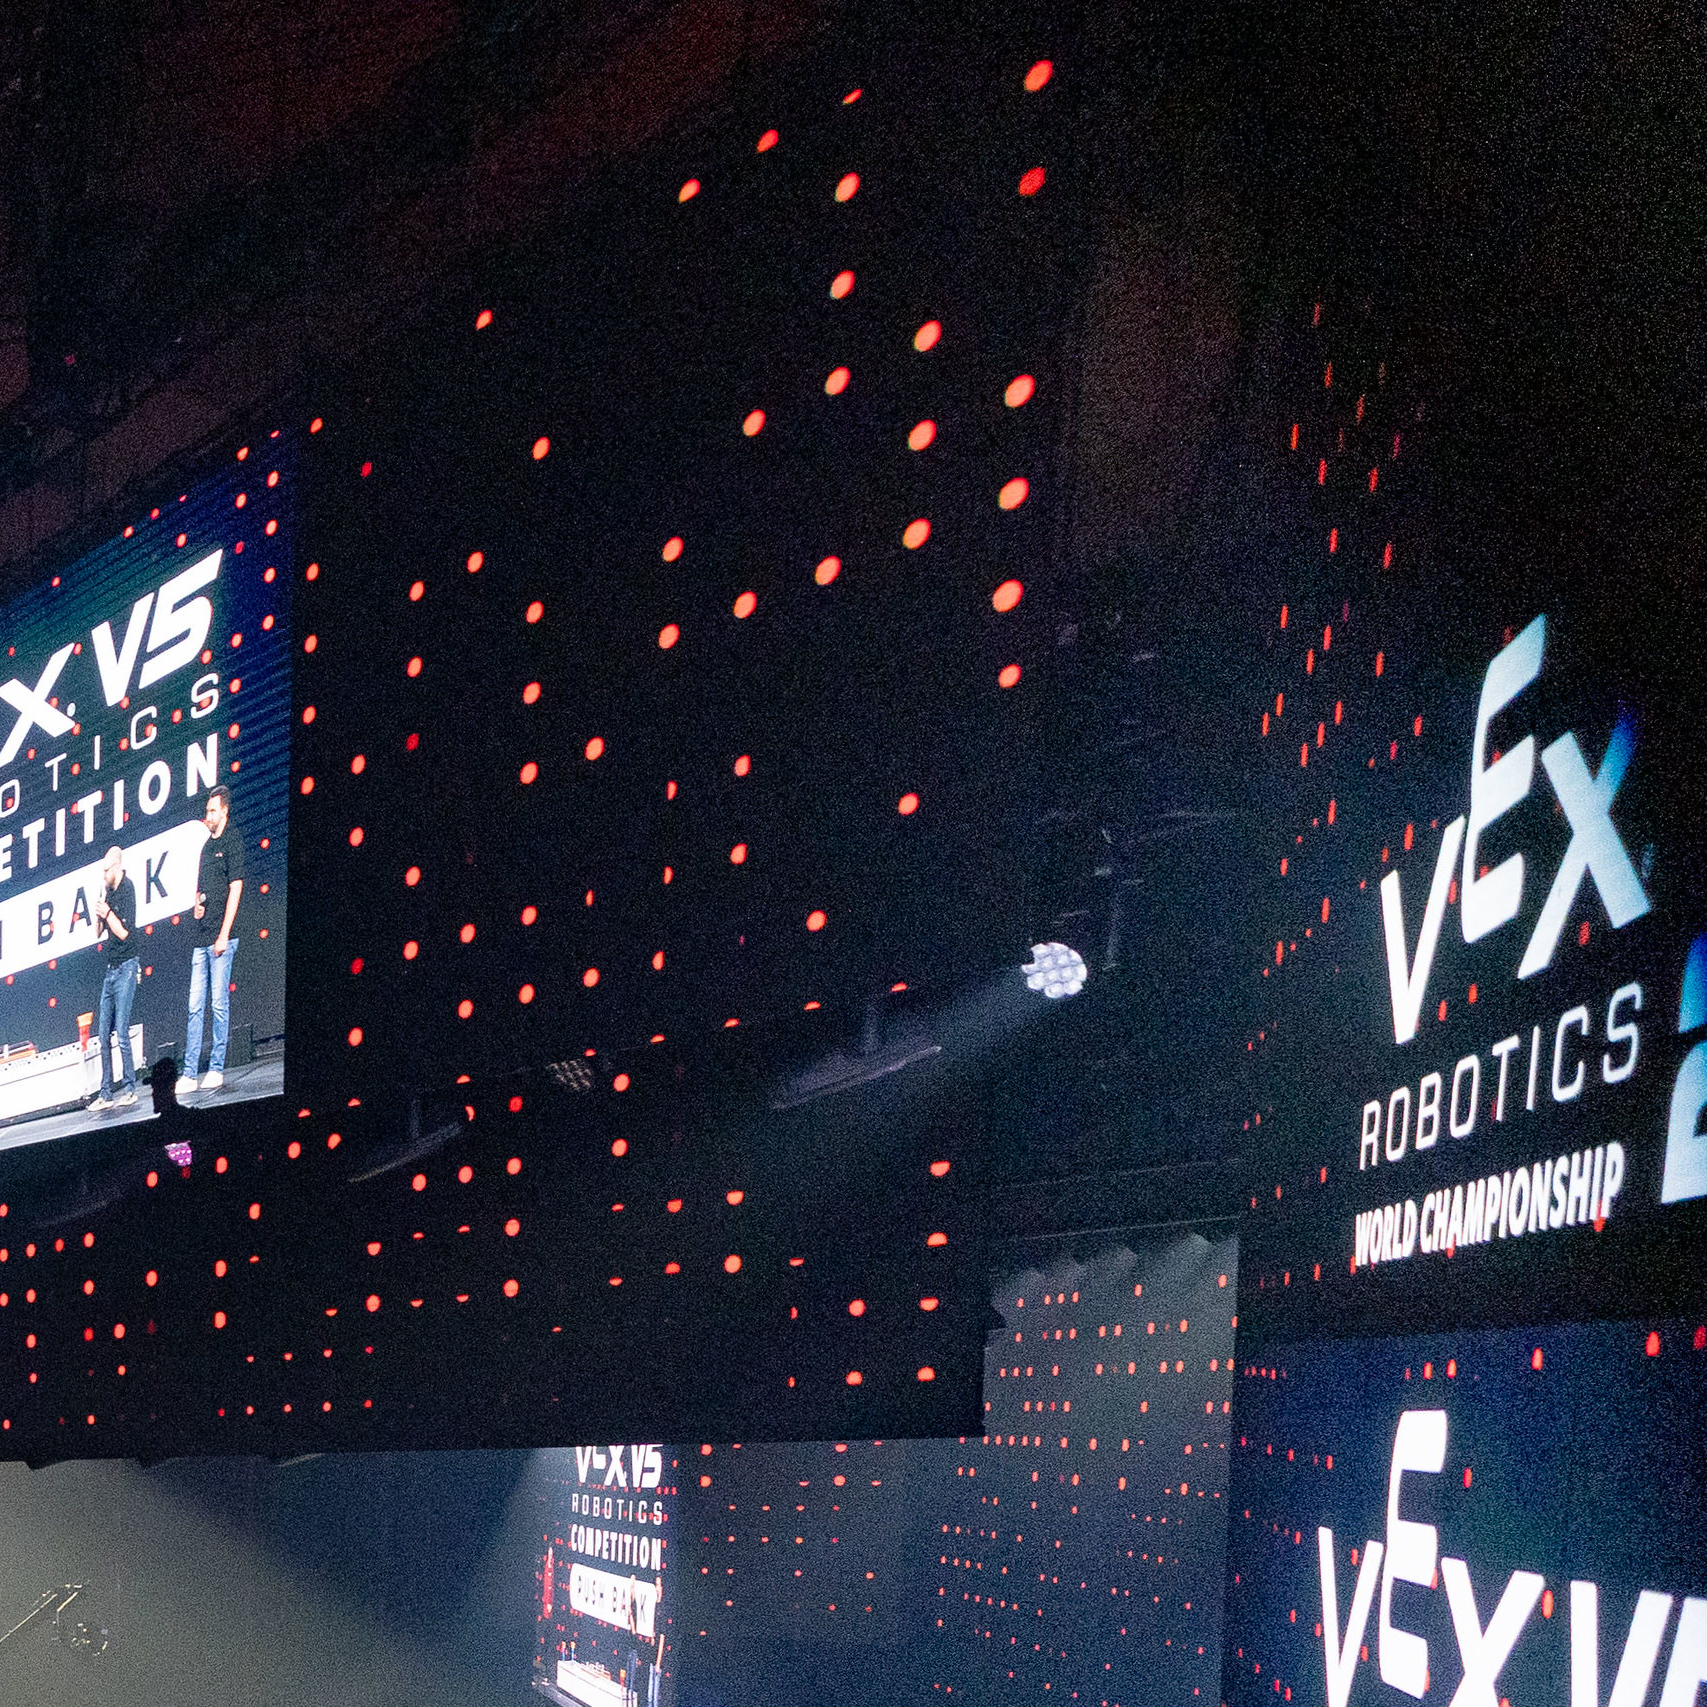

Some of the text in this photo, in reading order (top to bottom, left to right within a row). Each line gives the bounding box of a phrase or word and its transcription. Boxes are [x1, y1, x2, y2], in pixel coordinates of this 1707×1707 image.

[91, 549, 223, 710] V5
[1380, 614, 1651, 1045] VEX
[37, 850, 170, 946] BAK
[1359, 981, 1642, 1171] ROBOTICS
[1354, 1142, 1625, 1267] WORLD CHAMPIONSHIP
[570, 1524, 662, 1571] COMPETITION
[571, 1493, 664, 1526] ROBOTICS
[577, 1575, 648, 1627] PUSH BAK
